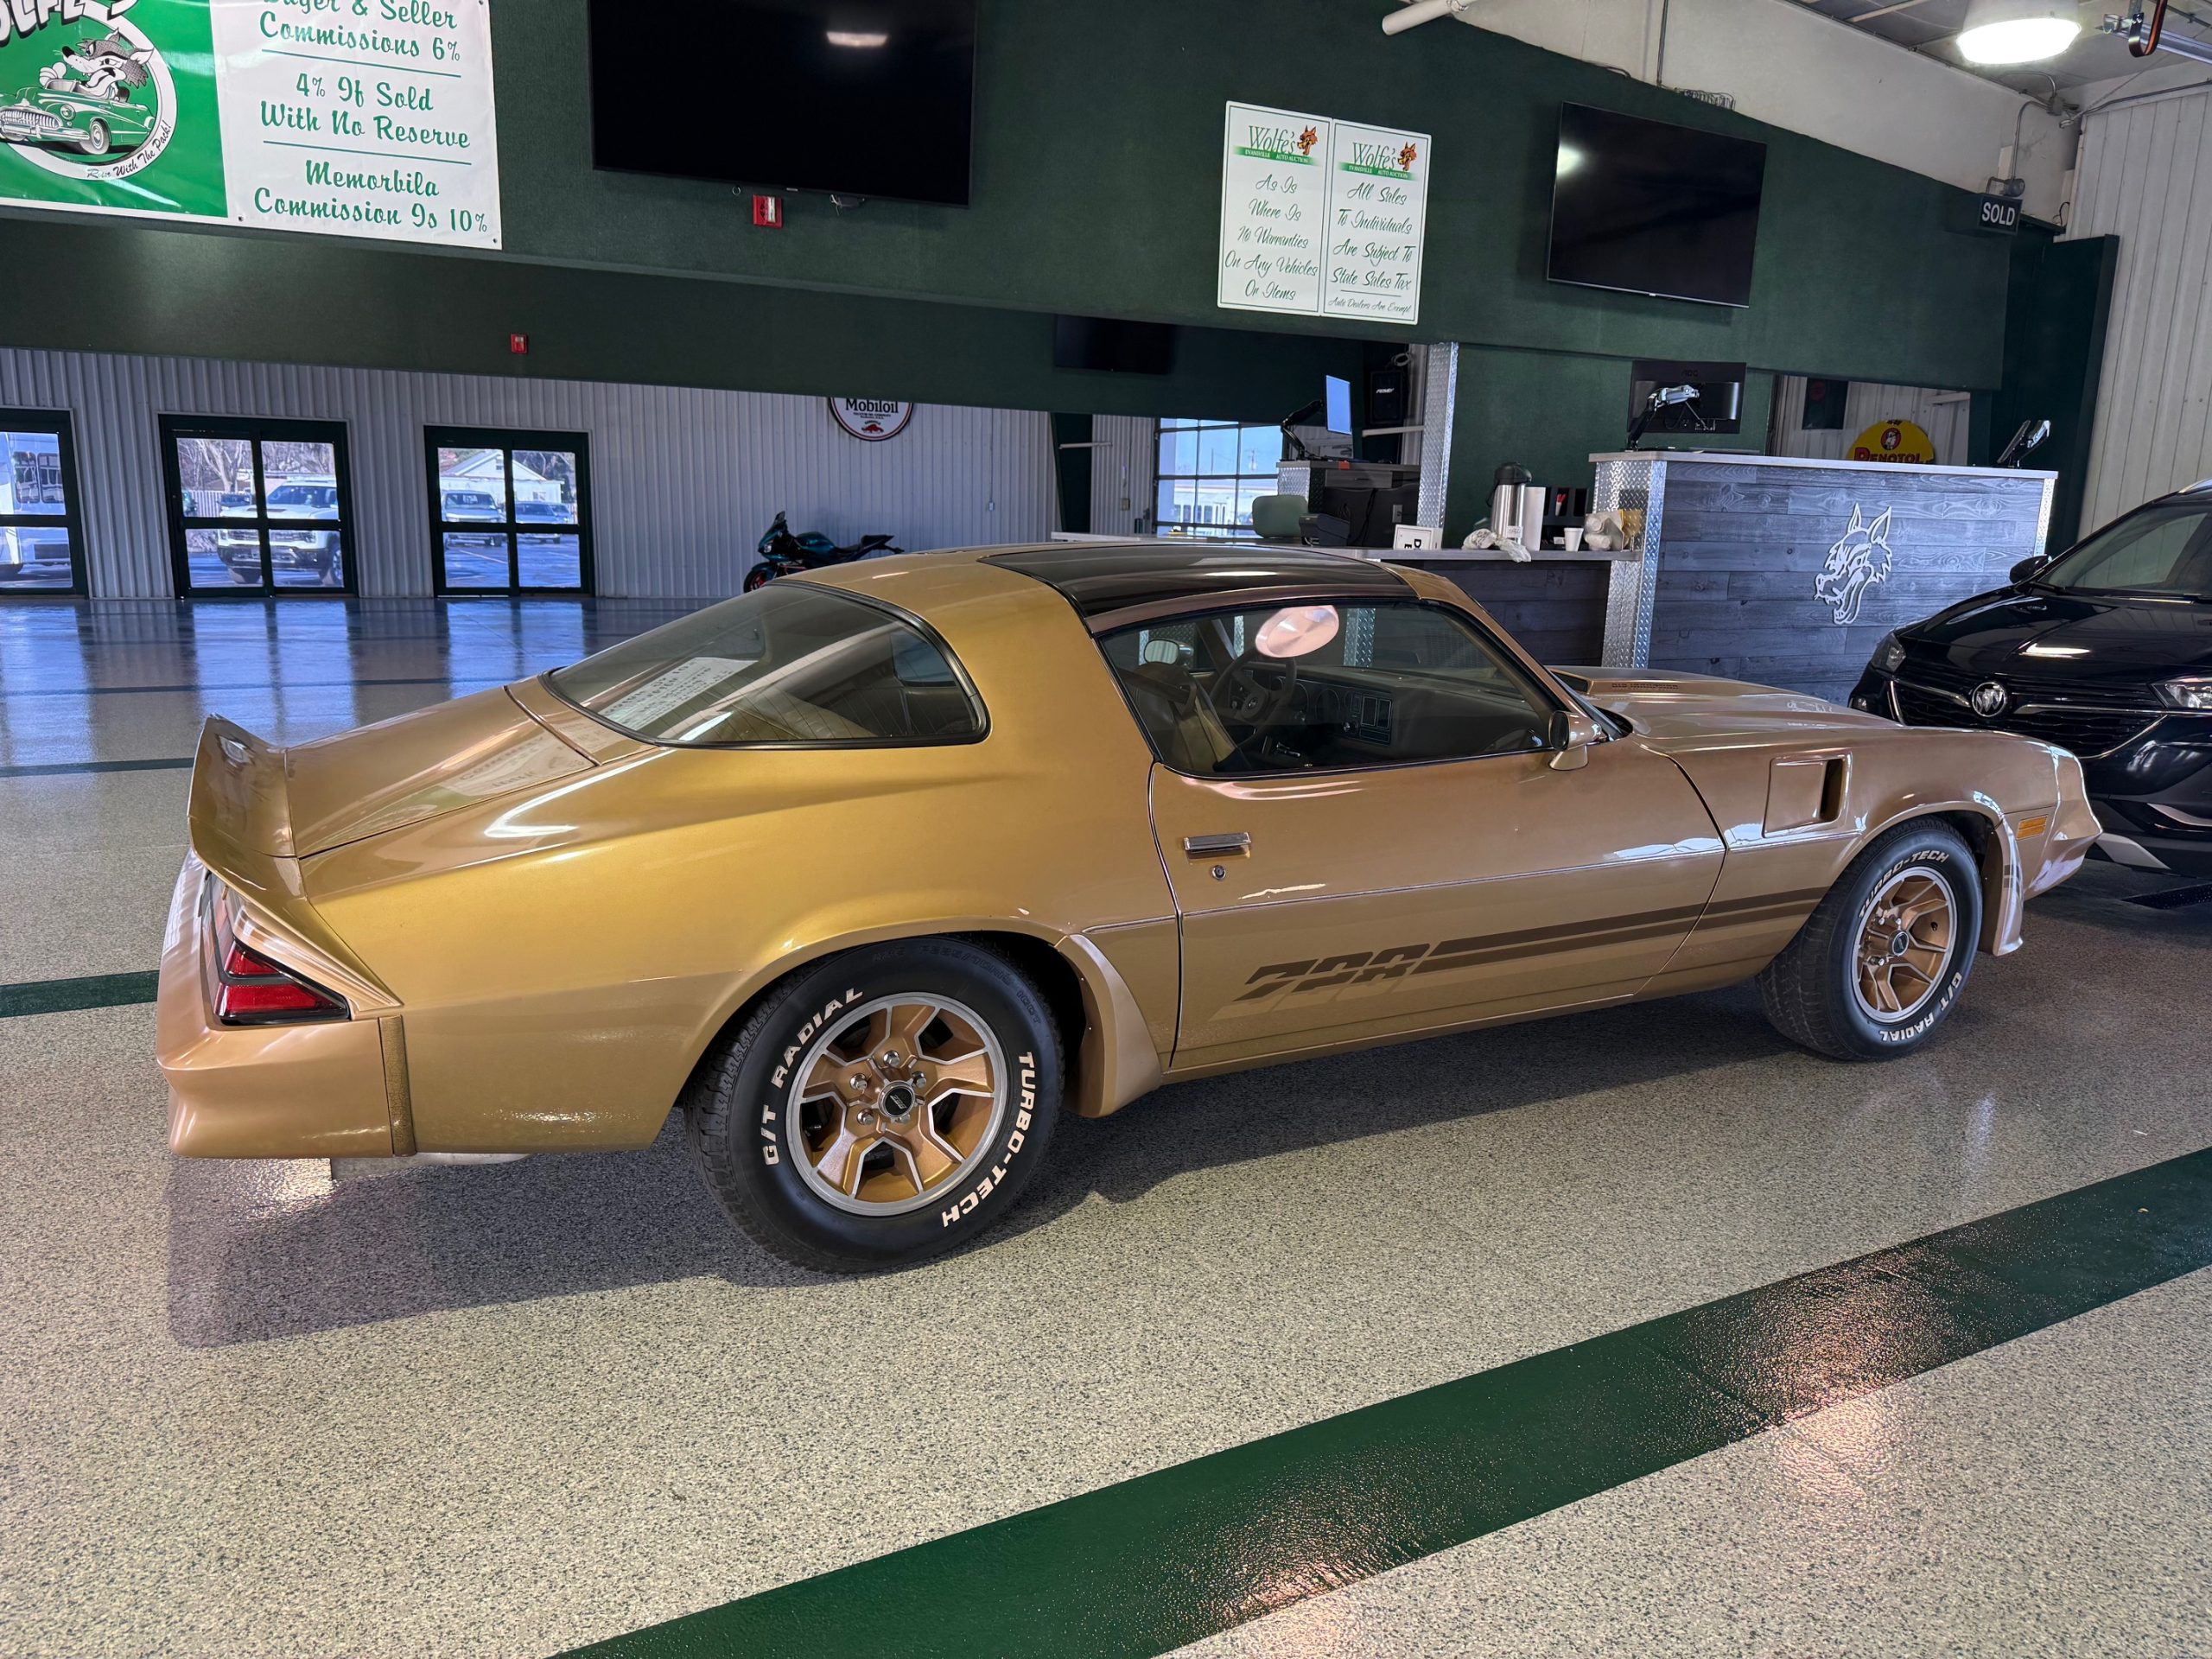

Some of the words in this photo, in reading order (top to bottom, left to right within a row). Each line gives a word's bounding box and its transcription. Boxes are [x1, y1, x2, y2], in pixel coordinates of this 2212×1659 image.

[380, 0, 457, 29] Seller
[260, 11, 420, 57] Commissions
[432, 37, 461, 61] 6%
[296, 73, 326, 97] 4%
[338, 76, 365, 107] If
[376, 82, 434, 111] Sold
[261, 100, 321, 131] With
[332, 110, 365, 137] No
[373, 115, 471, 148] Reserve
[112, 159, 139, 176] With
[137, 149, 156, 164] The
[152, 119, 172, 152] Pack!
[1249, 125, 1295, 155] Wolfe's
[1352, 142, 1396, 170] Wolfe's
[305, 159, 440, 197] Memorbila
[1255, 174, 1278, 191] As
[1281, 175, 1298, 194] Is
[1347, 181, 1375, 200] All
[1376, 187, 1408, 206] Sales
[254, 187, 402, 226] Commission
[411, 203, 438, 228] Is
[450, 208, 487, 232] 10%
[1249, 198, 1281, 219] Where
[1285, 203, 1302, 221] Is
[1338, 208, 1352, 226] To
[1351, 209, 1413, 234] Individuals
[1981, 201, 2016, 226] SOLD
[1237, 226, 1252, 242] No
[1254, 226, 1309, 249] Warranties
[1224, 250, 1241, 268] On
[1244, 254, 1273, 278] Any
[1275, 256, 1319, 276] Vehicles
[1332, 238, 1358, 257] Are
[1361, 241, 1401, 267] Subject
[1402, 245, 1417, 263] To
[1262, 281, 1297, 301] Items
[1330, 267, 1358, 285] State
[1362, 270, 1392, 289] Sales
[1394, 272, 1412, 290] Tax
[1347, 298, 1370, 309] Dealers
[1371, 301, 1386, 311] Are
[845, 398, 899, 413] Mobiloil
[1859, 849, 1950, 918] TURBO-TECH
[1940, 971, 1963, 1012] G/T
[1879, 1012, 1935, 1042] RADIAL
[760, 1104, 779, 1166] G/T
[771, 988, 863, 1089] RADIAL
[941, 1052, 1036, 1228] TURBO-TECH
